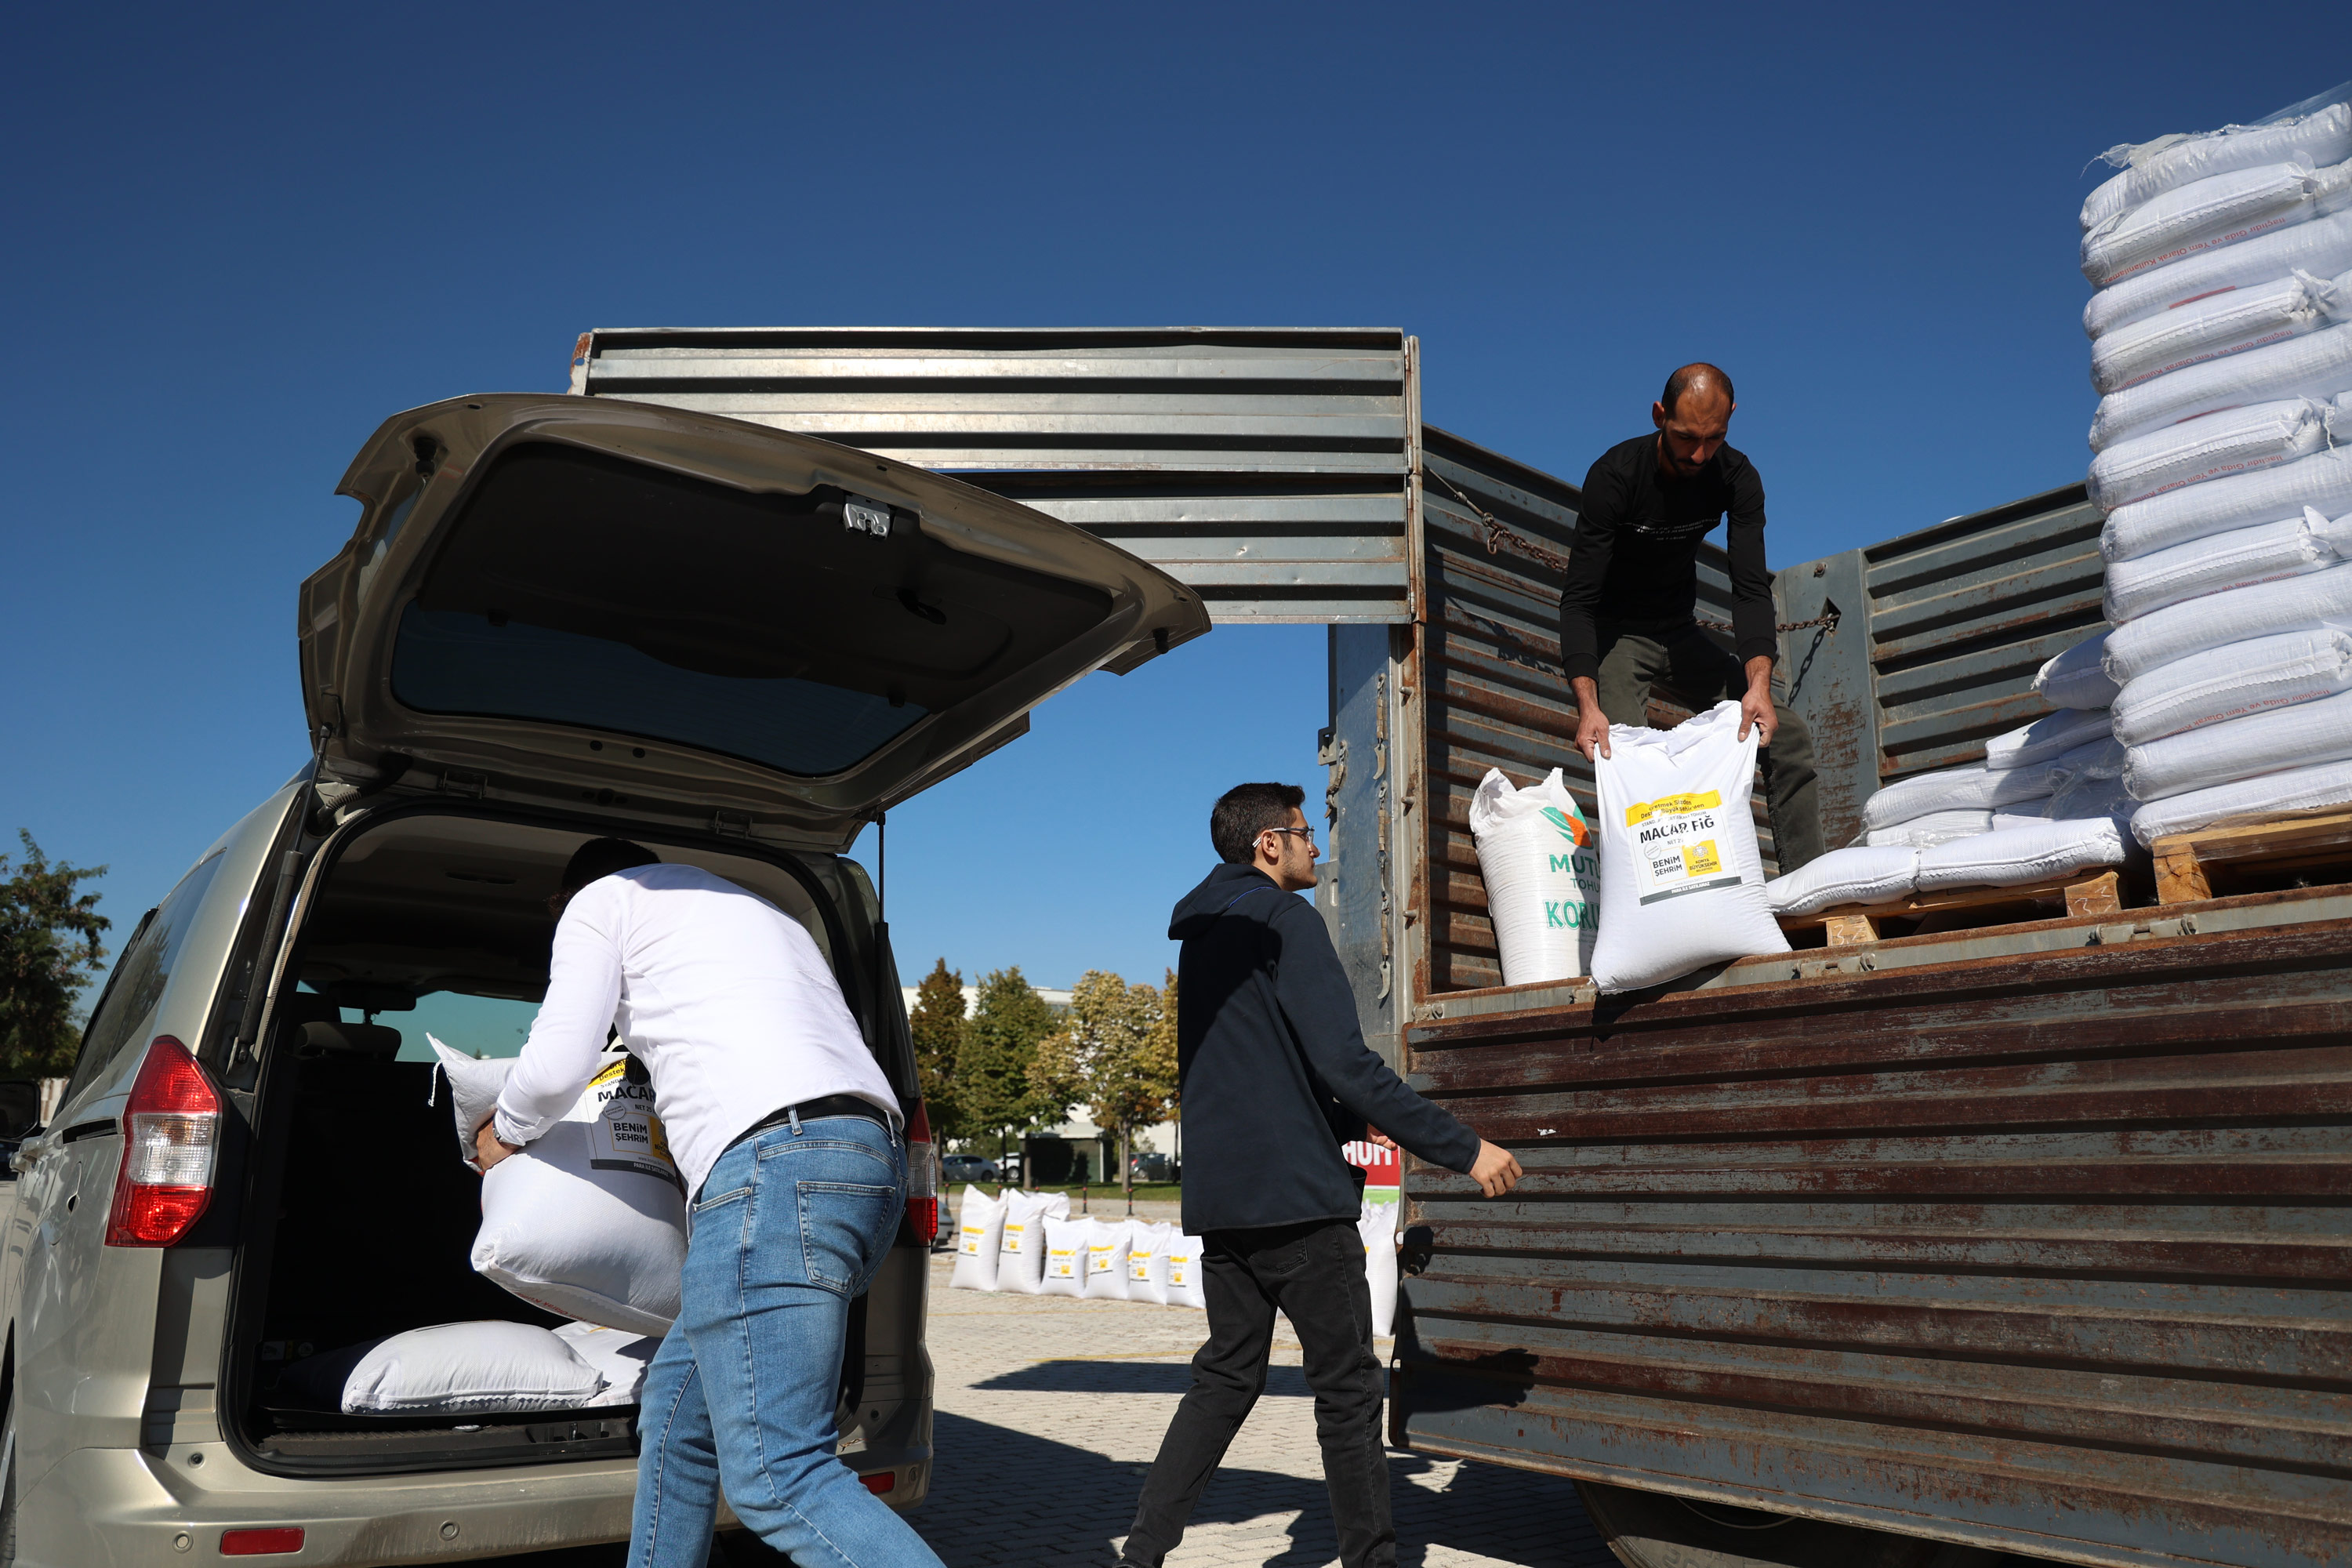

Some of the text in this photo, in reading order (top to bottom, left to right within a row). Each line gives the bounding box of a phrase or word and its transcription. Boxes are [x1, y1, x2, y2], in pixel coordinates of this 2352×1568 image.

[2224, 229, 2248, 241] Gıda
[2188, 241, 2211, 252] Yem
[2211, 237, 2223, 245] ve
[2158, 247, 2187, 262] Olarak
[2218, 347, 2230, 355] ve
[2164, 358, 2194, 371] Olarak
[2221, 463, 2245, 471] Gıda
[2187, 472, 2207, 483] Yem
[2157, 480, 2187, 493] Olarak
[2263, 698, 2289, 706] Gıda
[2226, 707, 2248, 717] Yem
[2194, 713, 2224, 726] Olarak
